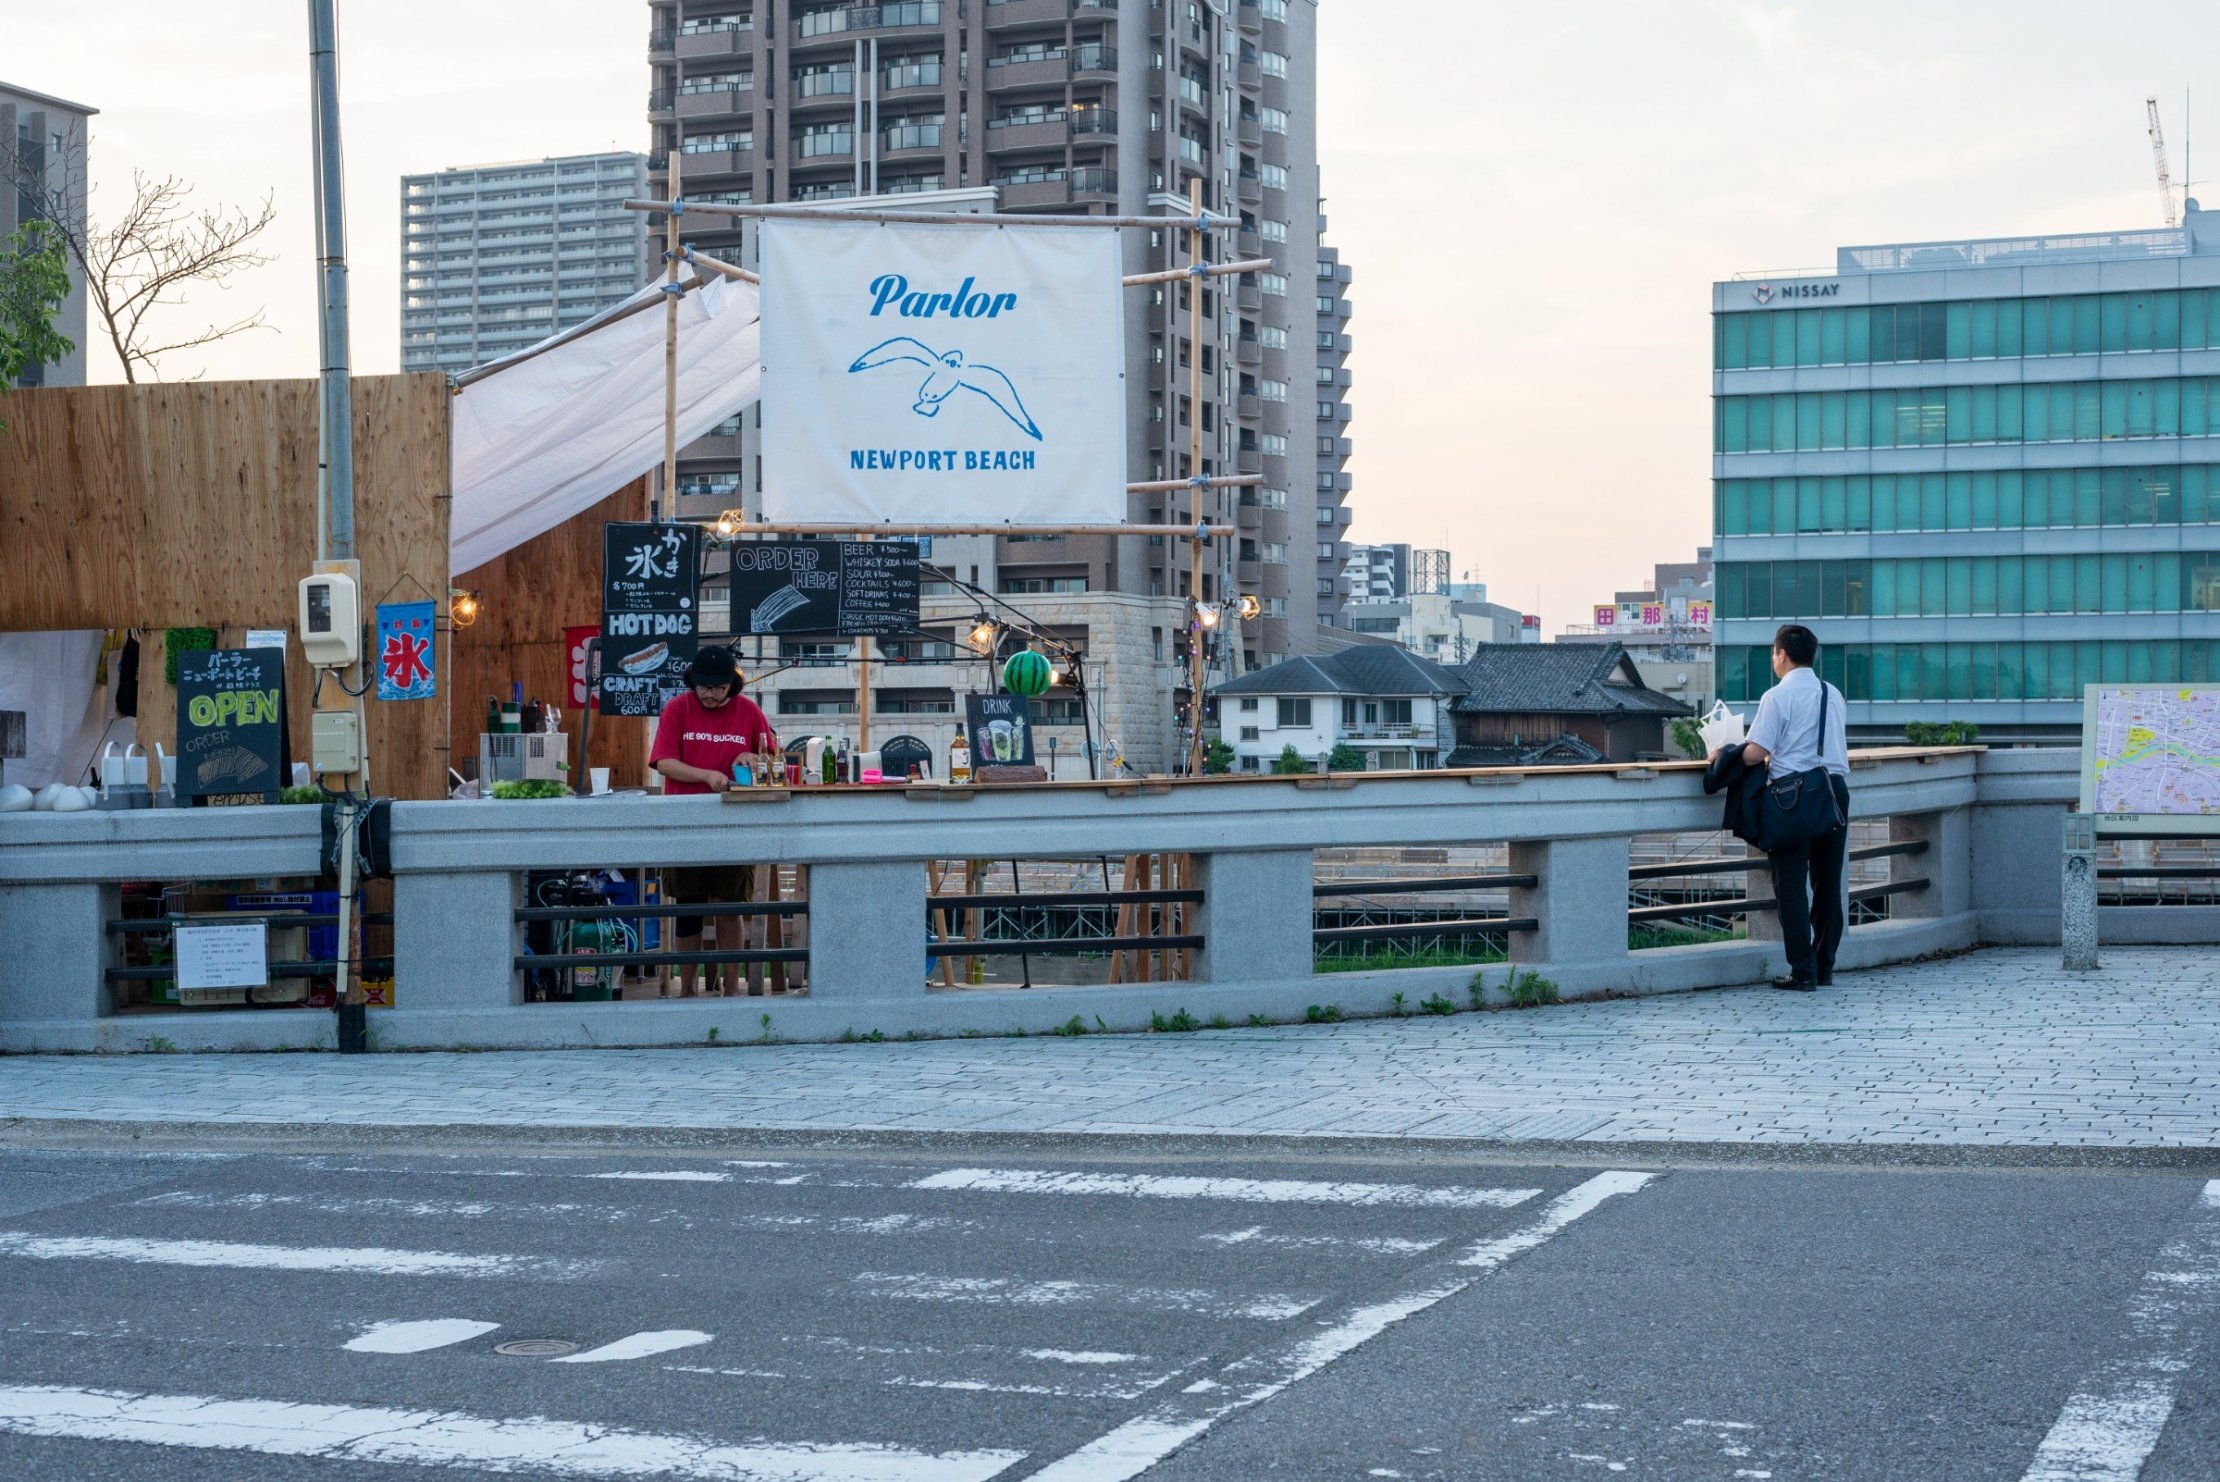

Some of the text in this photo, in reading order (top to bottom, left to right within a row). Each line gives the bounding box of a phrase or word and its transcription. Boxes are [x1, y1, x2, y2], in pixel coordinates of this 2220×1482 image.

[869, 274, 1017, 318] Parlor
[1782, 284, 1839, 298] NISSAY
[850, 449, 1035, 471] NEWPORT BEACH
[844, 543, 874, 555] BEER
[736, 546, 819, 571] ORDER
[844, 557, 881, 568] WHISKEY
[884, 558, 900, 567] SODA
[792, 571, 839, 590] HERE
[846, 568, 872, 578] SOUR
[845, 580, 890, 588] COCKTAILS
[845, 599, 873, 608] COFFEE
[208, 651, 252, 667] パーラー
[382, 631, 434, 691] 氷
[183, 665, 261, 682] ニューポートビーチ
[603, 676, 657, 693] CRAFT
[615, 691, 659, 706] DRAFT
[983, 698, 1013, 715] DRINK
[189, 688, 280, 727] OPEN
[186, 729, 231, 753] ORDER
